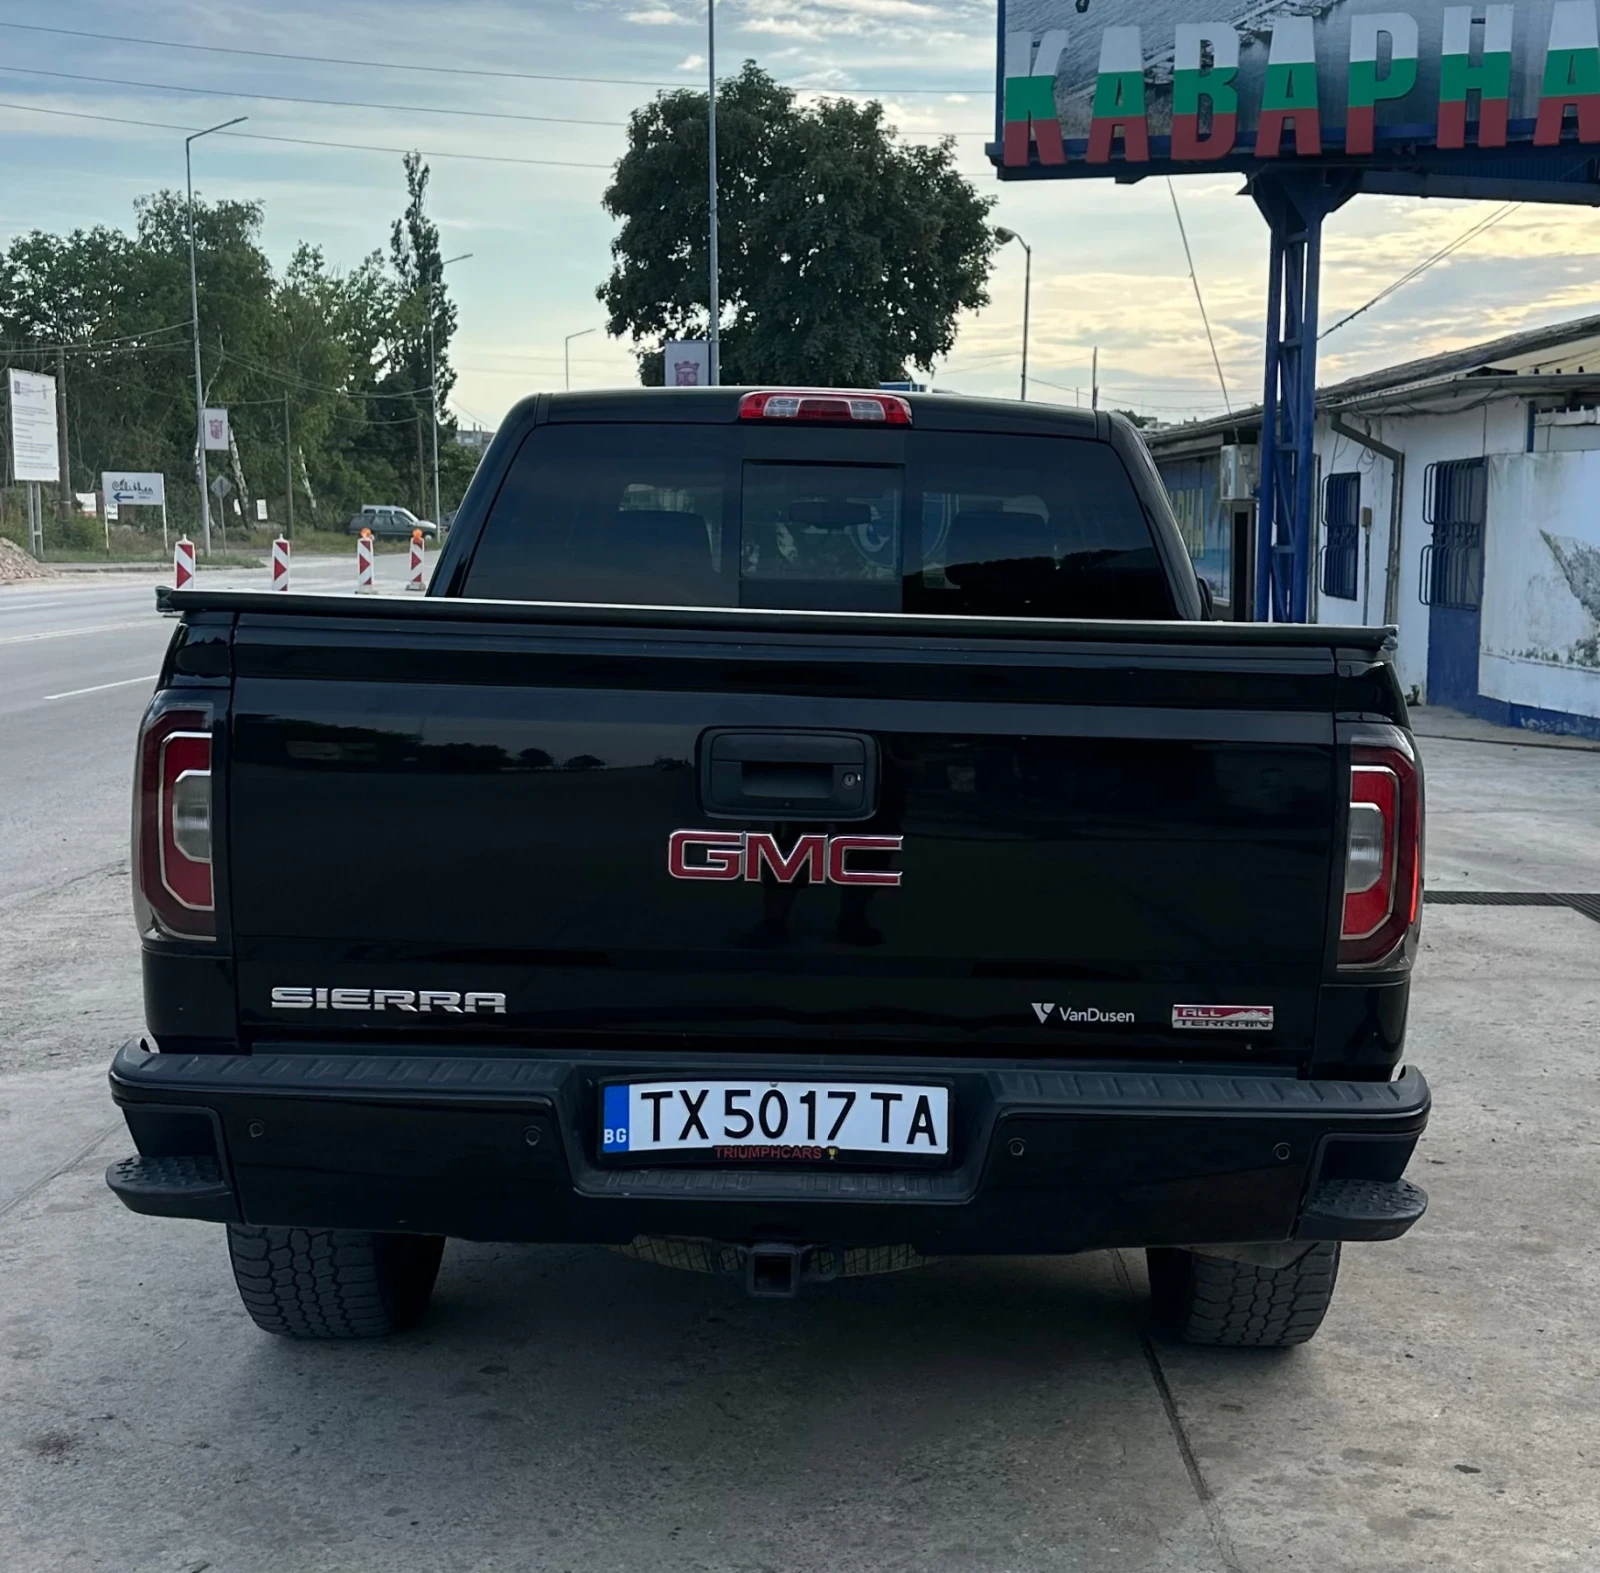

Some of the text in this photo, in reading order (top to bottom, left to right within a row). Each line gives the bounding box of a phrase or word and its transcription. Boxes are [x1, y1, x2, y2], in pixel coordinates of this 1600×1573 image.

[1003, 0, 1600, 167] КАВАРНА
[668, 828, 903, 886] GMC
[271, 987, 507, 1014] SIERRA
[1059, 1007, 1135, 1023] VanDusen
[1182, 1008, 1222, 1017] ALL
[1180, 1019, 1269, 1028] TERRAIN
[641, 1089, 938, 1147] TX 5017 TA
[603, 1128, 627, 1144] BG
[714, 1146, 822, 1160] TRIUMPHCARS
